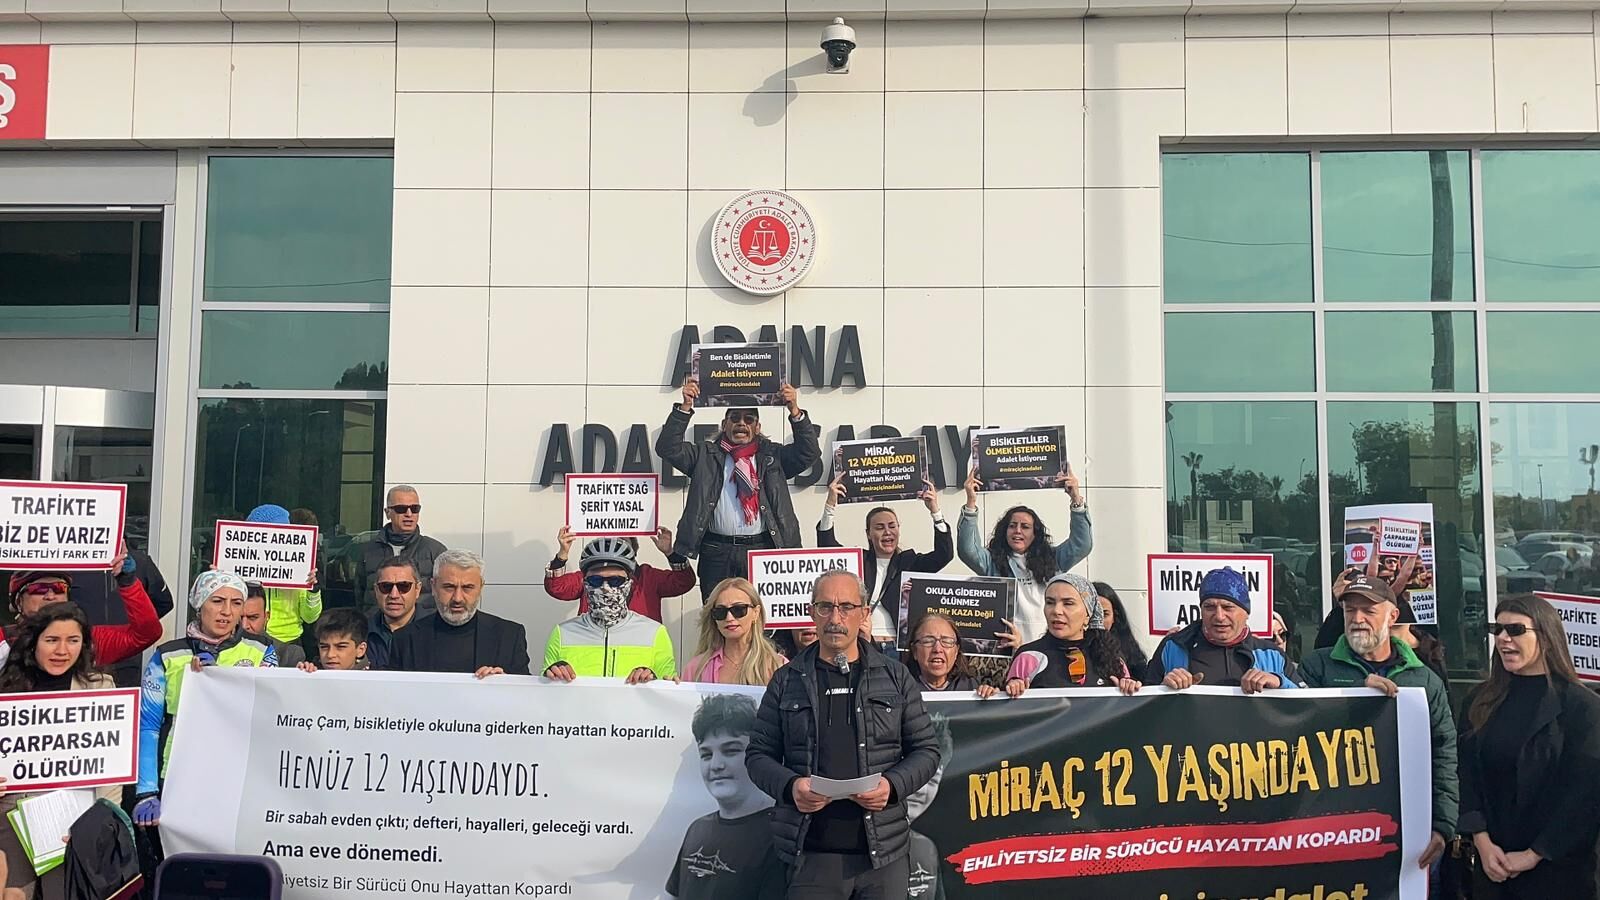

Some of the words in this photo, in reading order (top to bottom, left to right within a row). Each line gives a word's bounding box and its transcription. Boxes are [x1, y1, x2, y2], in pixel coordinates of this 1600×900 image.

[733, 208, 770, 239] CUMHURİYETİ
[772, 210, 795, 231] ADALET
[671, 325, 866, 388] ANA
[710, 370, 734, 378] Adalet
[736, 369, 772, 379] İstiyorum
[990, 435, 1049, 446] BİSİKLETLİLER
[864, 445, 895, 456] MİRAÇ
[986, 446, 1012, 456] ÖLMEK
[1014, 444, 1056, 454] İSTEMİYOR
[848, 459, 858, 467] 12
[860, 454, 916, 467] YAŞINDAYDI
[1018, 454, 1047, 463] İstiyoruz
[849, 468, 880, 477] Ehliyetsiz
[891, 466, 914, 474] Sürücü
[854, 475, 884, 484] Hayattan
[885, 474, 910, 482] Kopardı
[576, 482, 626, 494] TRAFİKTE
[628, 482, 648, 494] SAĞ
[11, 493, 97, 516] TRAFİKTE
[580, 498, 610, 515] ŞERİT
[613, 501, 644, 512] YASAL
[586, 518, 639, 529] HAKKIMIZ!
[27, 526, 50, 544] DE
[56, 526, 110, 544] VARIZ!
[226, 530, 268, 543] SADECE
[270, 533, 307, 546] ARABA
[62, 550, 89, 559] FARK
[92, 550, 108, 559] ET!
[224, 546, 260, 560] SENİN.
[264, 550, 305, 562] YOLLAR
[234, 564, 293, 580] HEPİMİZİN!
[763, 560, 794, 574] YOLU
[1160, 565, 1203, 591] MİRA
[926, 587, 954, 596] OKULA
[955, 587, 996, 598] GİDERKEN
[940, 597, 980, 606] ÖLÜNMEZ
[951, 609, 973, 617] KAZA
[975, 610, 994, 619] Değil
[1558, 608, 1597, 624] RAFİKTE
[277, 714, 313, 730] Miraç
[317, 715, 350, 731] Çam,
[354, 716, 425, 733] bisikletiyle
[428, 718, 481, 733] okuluna
[485, 721, 544, 736] giderken
[548, 722, 607, 738] hayattan
[611, 724, 675, 740] koparıldı.
[0, 730, 120, 758] ÇARPARSAN
[13, 756, 105, 780] ÖLÜRÜM!
[364, 753, 389, 792] 12
[969, 760, 1085, 820] MİRAÇ
[1094, 748, 1136, 806] 12
[1143, 726, 1380, 812] YAŞINDAYDI
[266, 810, 284, 823] Bir
[288, 812, 327, 825] sabah
[331, 814, 372, 826] evden
[376, 815, 409, 830] çıktı;
[413, 816, 462, 832] defteri,
[466, 817, 528, 834] hayalleri,
[532, 820, 590, 836] geleceği
[595, 821, 633, 834] vardı.
[262, 841, 304, 857] Ama
[310, 845, 341, 859] eve
[346, 843, 442, 863] dönemedi.
[963, 848, 1067, 872] EHLİYETSİZ
[1070, 844, 1101, 861] BİR
[1105, 836, 1183, 859] SÜRÜCÜ
[1186, 835, 1292, 853] HAYATTAN
[1296, 827, 1381, 849] KOPARDI
[333, 876, 352, 890] Bir
[356, 877, 406, 892] Sürücü
[411, 880, 439, 892] Onu
[444, 881, 509, 897] Hayattan
[515, 882, 572, 897] Kopardı
